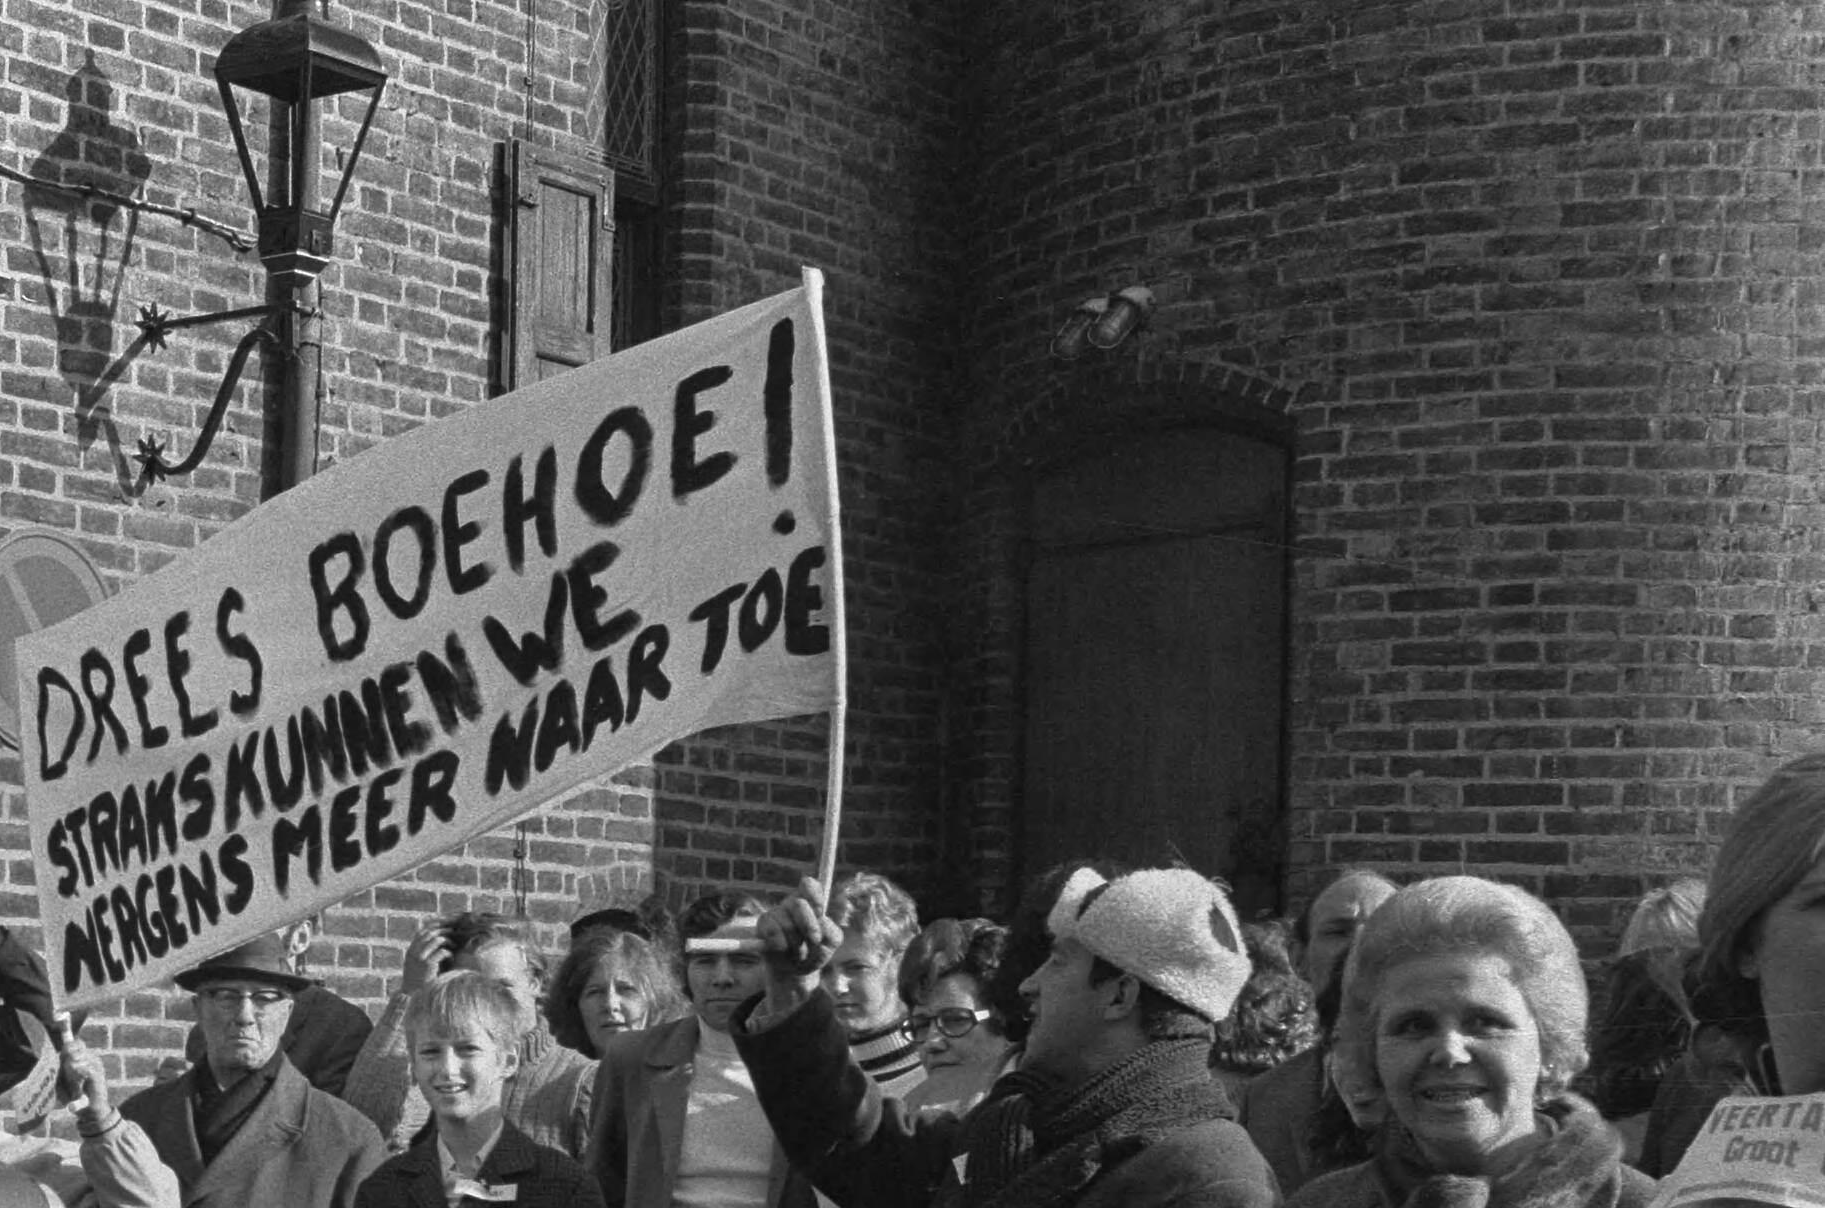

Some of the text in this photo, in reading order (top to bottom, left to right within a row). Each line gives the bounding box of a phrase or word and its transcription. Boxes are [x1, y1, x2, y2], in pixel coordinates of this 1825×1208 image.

[37, 317, 797, 781] DREES BOEHOE!
[47, 541, 644, 899] STRAKS KUNNEN WE
[63, 545, 831, 994] NERGENS MEER NAAR TOE
[1724, 1135, 1801, 1168] Groot
